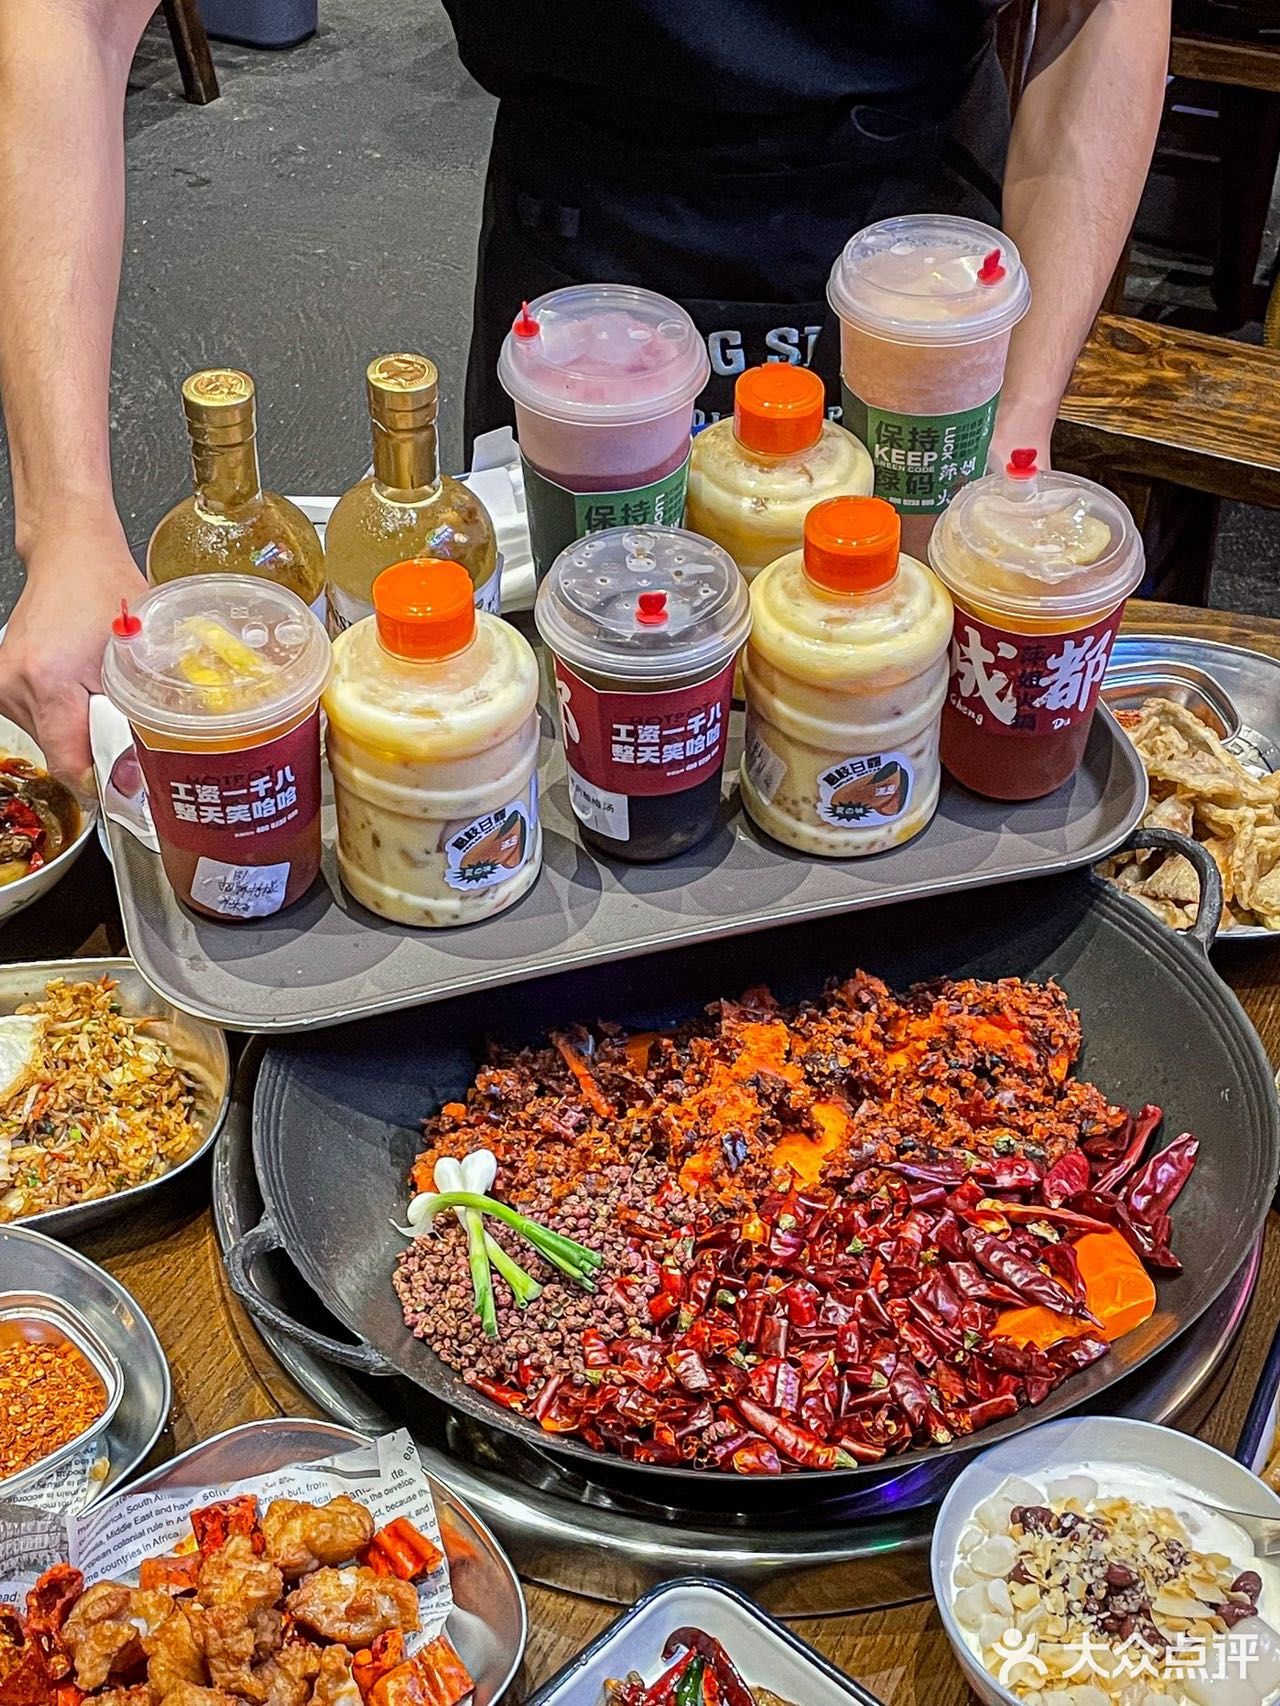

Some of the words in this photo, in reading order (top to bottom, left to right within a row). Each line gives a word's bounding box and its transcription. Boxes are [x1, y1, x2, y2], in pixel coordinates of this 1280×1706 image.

[875, 420, 940, 451] 保持
[941, 426, 957, 461] LUCK
[874, 444, 938, 468] KEEP
[907, 465, 935, 473] CODE
[585, 499, 651, 532] 保持
[951, 625, 1113, 726] 成都
[612, 702, 722, 744] 工资一千八
[611, 723, 721, 765] 整天笑哈哈
[169, 765, 296, 803] 工资一千八
[172, 786, 298, 825] 整天笑哈哈
[126, 1497, 153, 1515] South
[369, 1491, 383, 1502] the
[106, 1522, 132, 1541] Middle
[133, 1510, 153, 1525] East
[155, 1505, 172, 1517] and
[113, 1529, 146, 1551] colonial
[146, 1521, 164, 1534] rule
[100, 1548, 142, 1574] countries
[142, 1542, 151, 1551] in
[152, 1531, 183, 1548] Africa.
